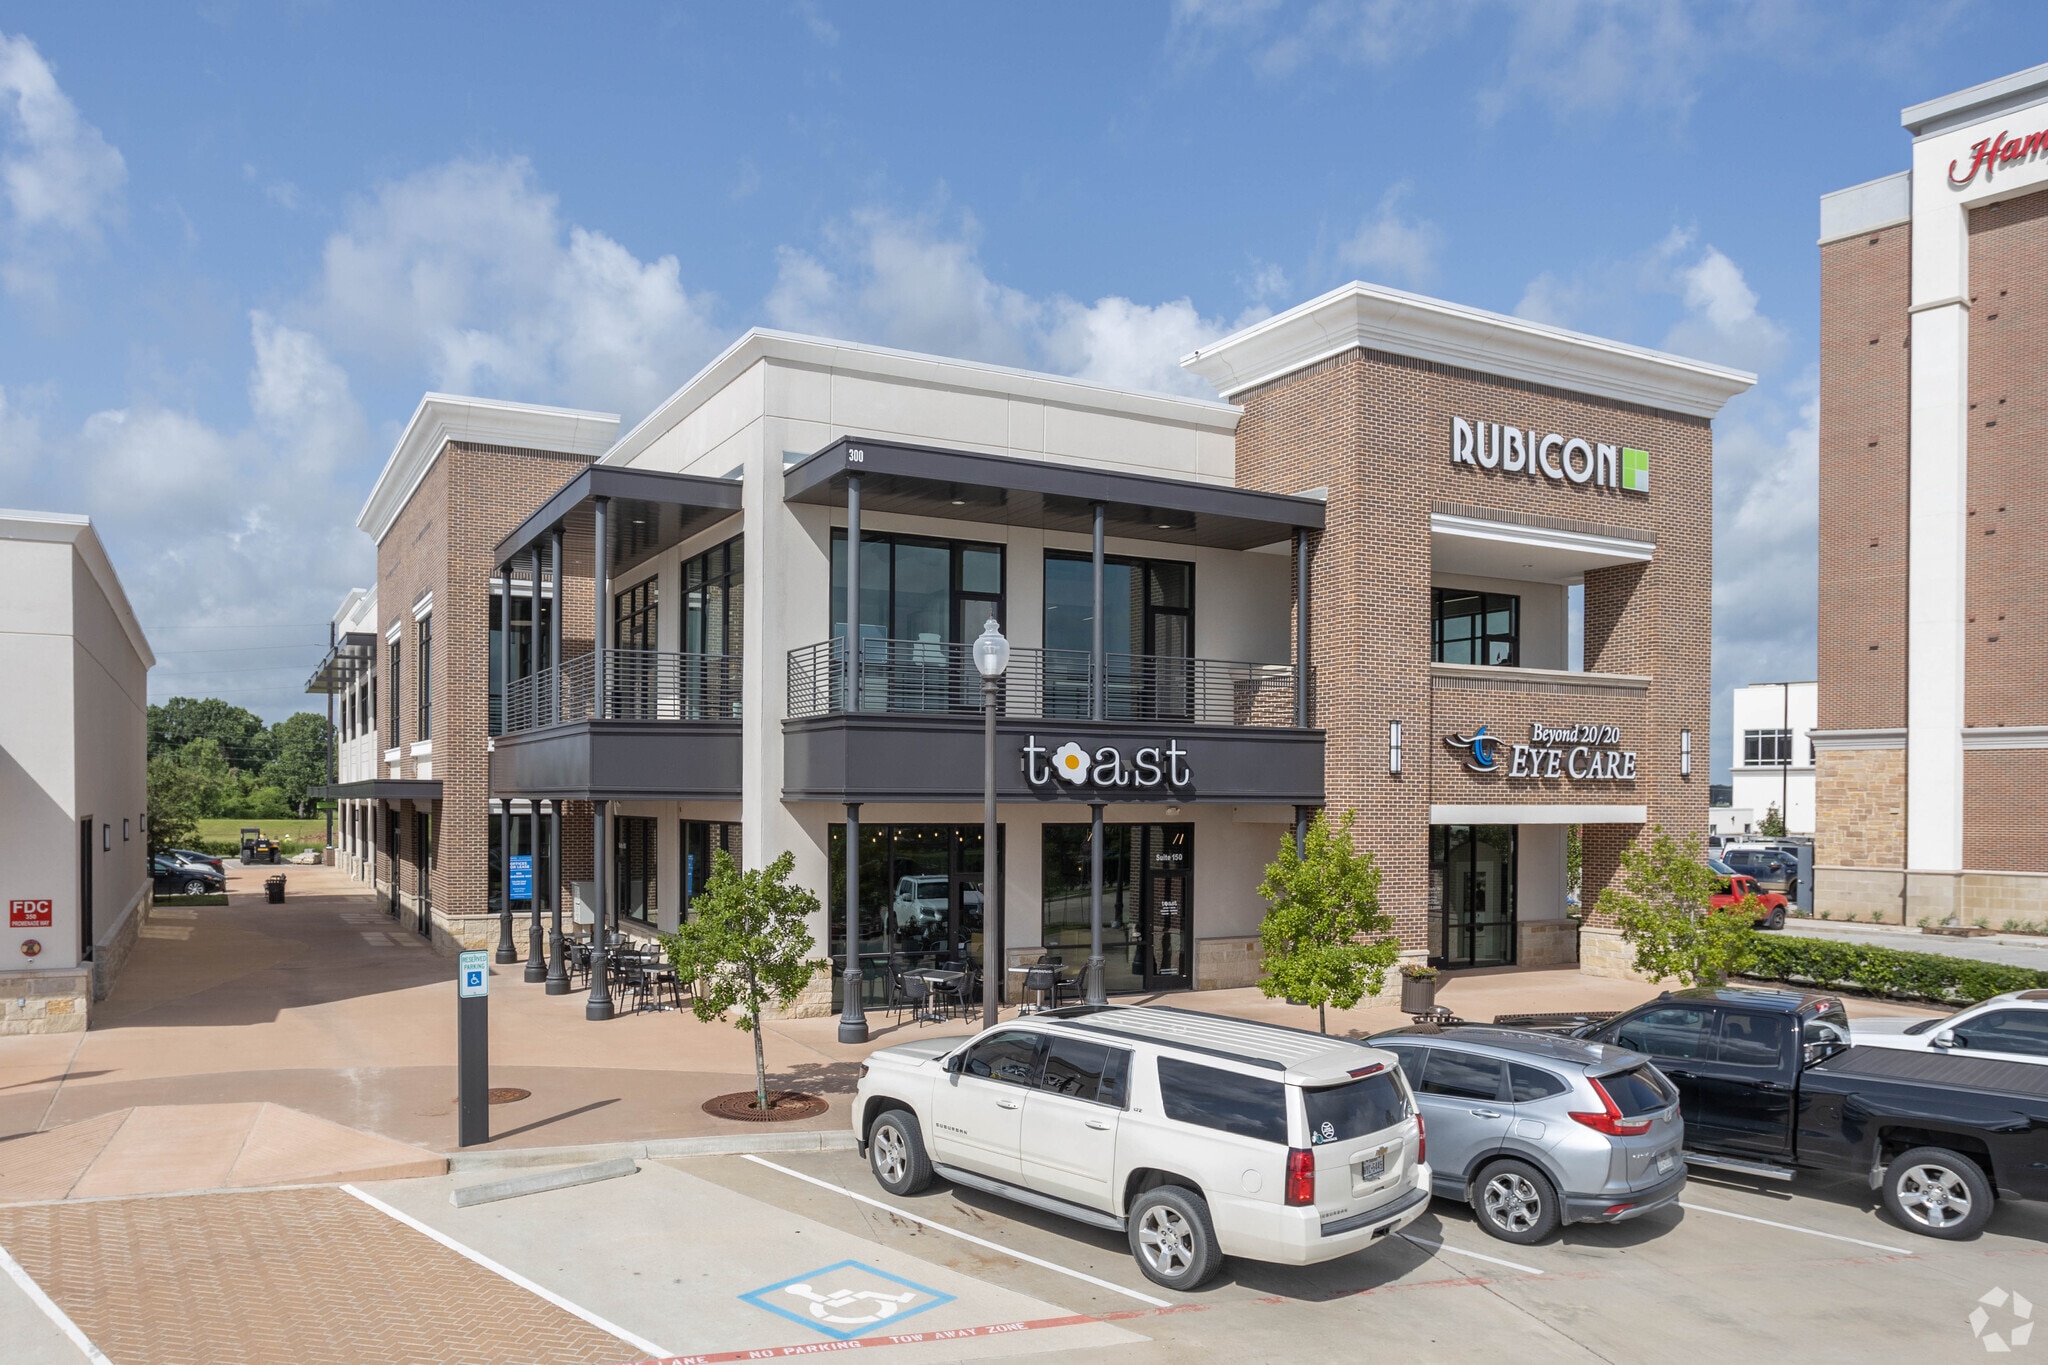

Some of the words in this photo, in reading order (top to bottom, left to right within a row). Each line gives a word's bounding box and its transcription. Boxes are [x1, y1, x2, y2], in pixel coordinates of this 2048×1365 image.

[848, 448, 864, 463] 300
[1453, 416, 1617, 488] RUBICON
[1532, 723, 1580, 747] Beyond
[1580, 725, 1620, 746] 20/20
[1508, 745, 1563, 778] EYE
[1568, 746, 1637, 779] CARE
[1172, 853, 1183, 861] 150
[12, 900, 49, 914] FDC
[462, 955, 487, 963] RESERVED
[935, 1122, 968, 1135] SUBURBAN
[749, 1349, 774, 1359] NO
[783, 1340, 861, 1356] PARKING
[889, 1333, 923, 1345] TOW
[935, 1328, 977, 1340] AWAY
[985, 1322, 1029, 1334] ZONE
